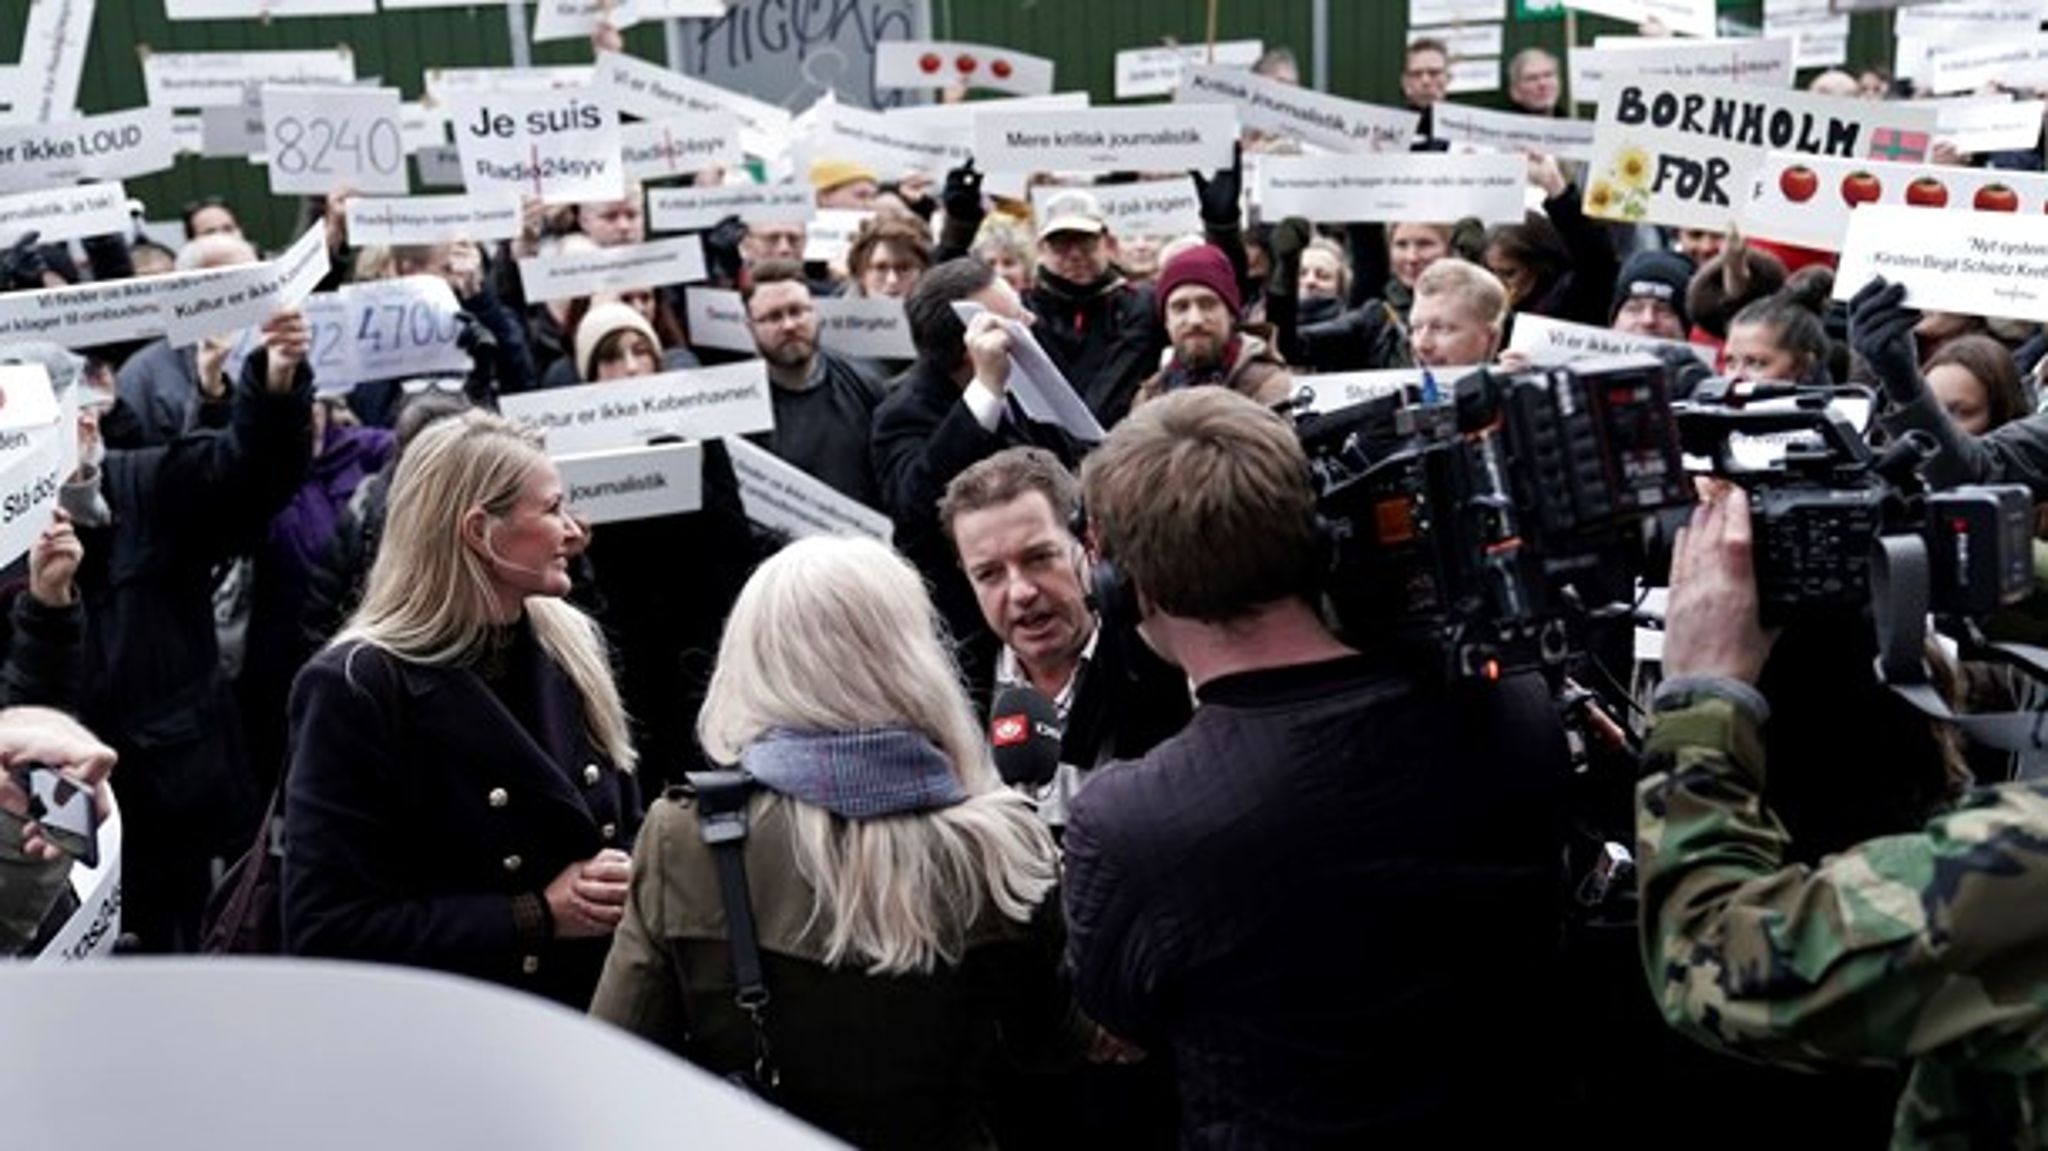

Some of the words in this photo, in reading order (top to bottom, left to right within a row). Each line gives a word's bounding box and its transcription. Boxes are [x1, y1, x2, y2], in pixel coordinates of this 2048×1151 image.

[469, 106, 515, 138] Je
[526, 98, 602, 135] suis
[1616, 86, 1861, 158] BORNHOLM
[22, 136, 75, 161] ikke
[79, 124, 143, 155] LOUD
[273, 115, 400, 176] 8240
[1006, 131, 1050, 148] Mere
[1054, 129, 1104, 147] kritisk
[1109, 128, 1200, 150] journalistik
[476, 156, 605, 182] Radio24syv
[1651, 153, 1730, 207] FOR
[174, 295, 224, 320] Kultur
[577, 408, 597, 425] er
[600, 402, 640, 419] ikke
[569, 471, 669, 503] journalistik
